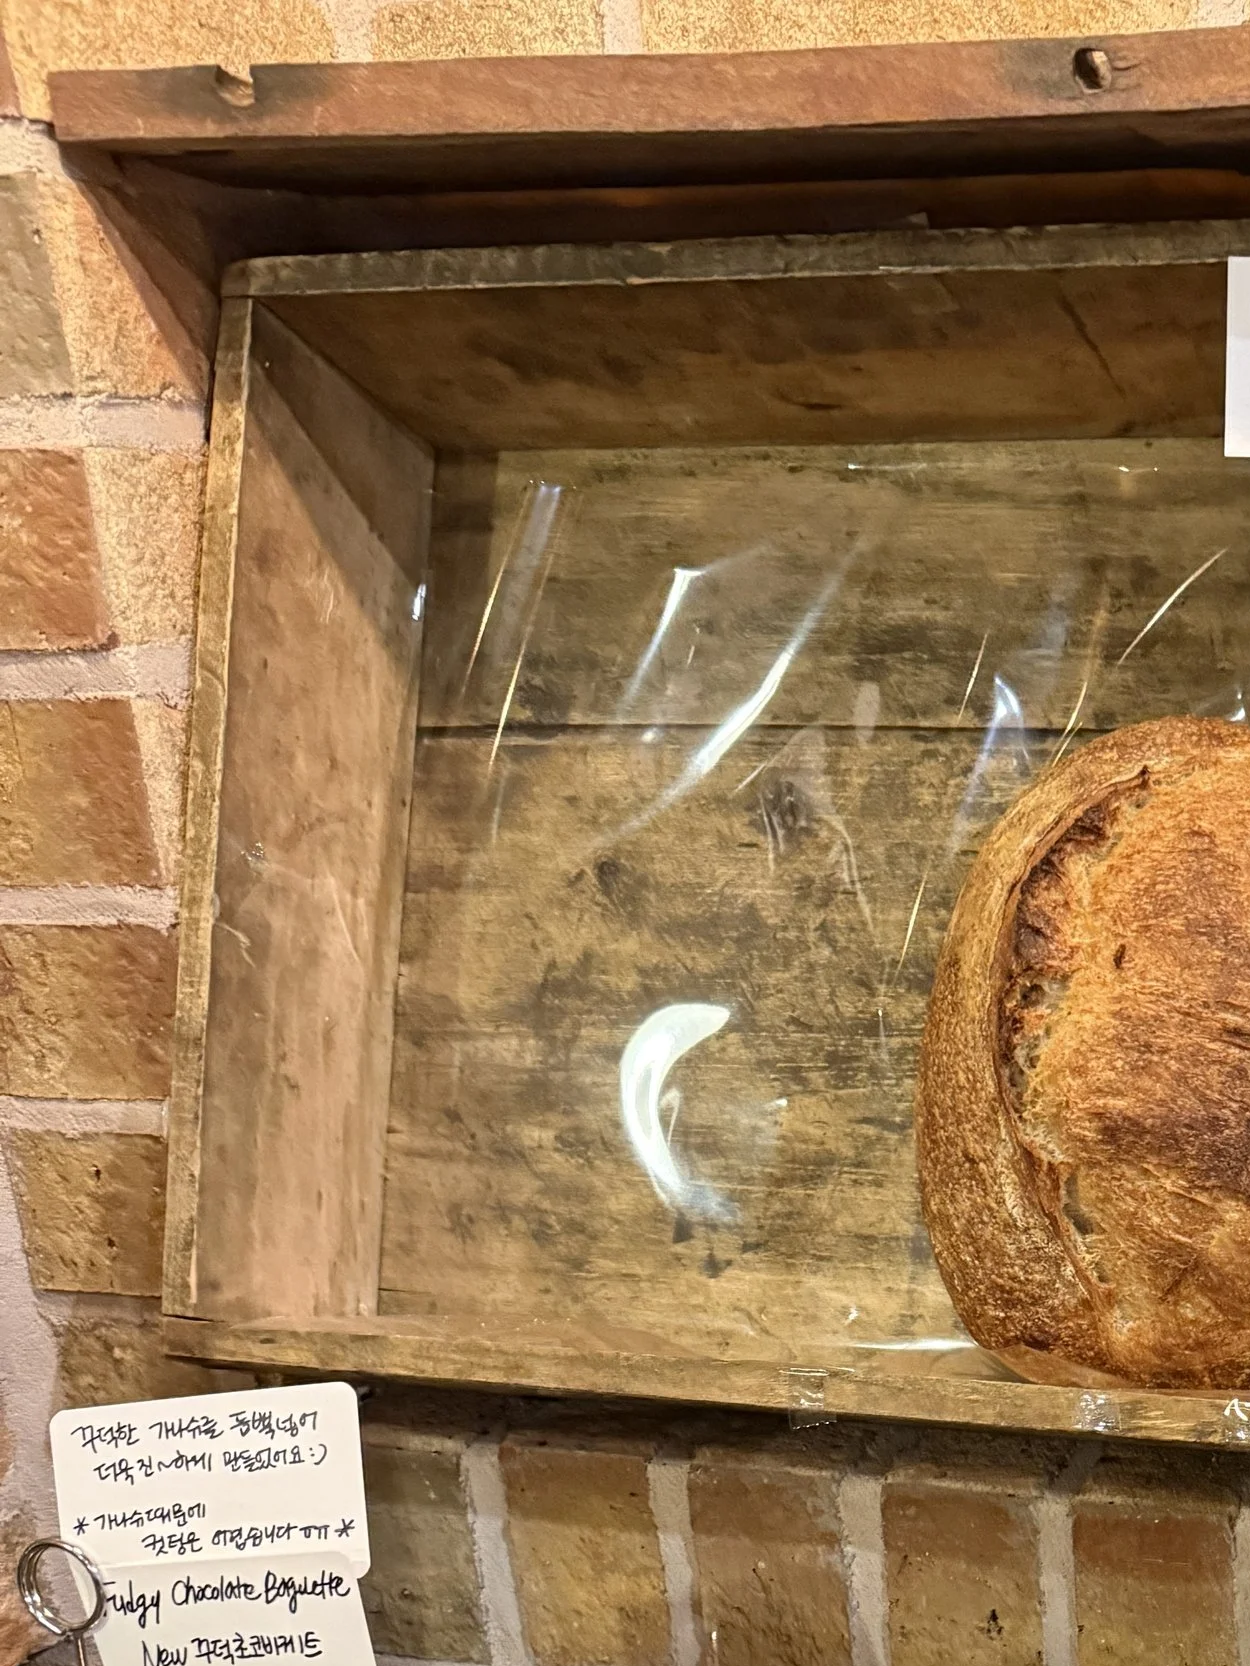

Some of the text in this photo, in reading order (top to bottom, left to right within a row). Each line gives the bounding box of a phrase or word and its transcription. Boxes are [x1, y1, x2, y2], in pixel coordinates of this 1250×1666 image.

[70, 1421, 139, 1453] 꾸덕한
[149, 1416, 224, 1441] 가나슈를
[141, 1531, 203, 1556] 컷팅은
[171, 1575, 262, 1606] Chocolate
[263, 1570, 351, 1614] Baguette
